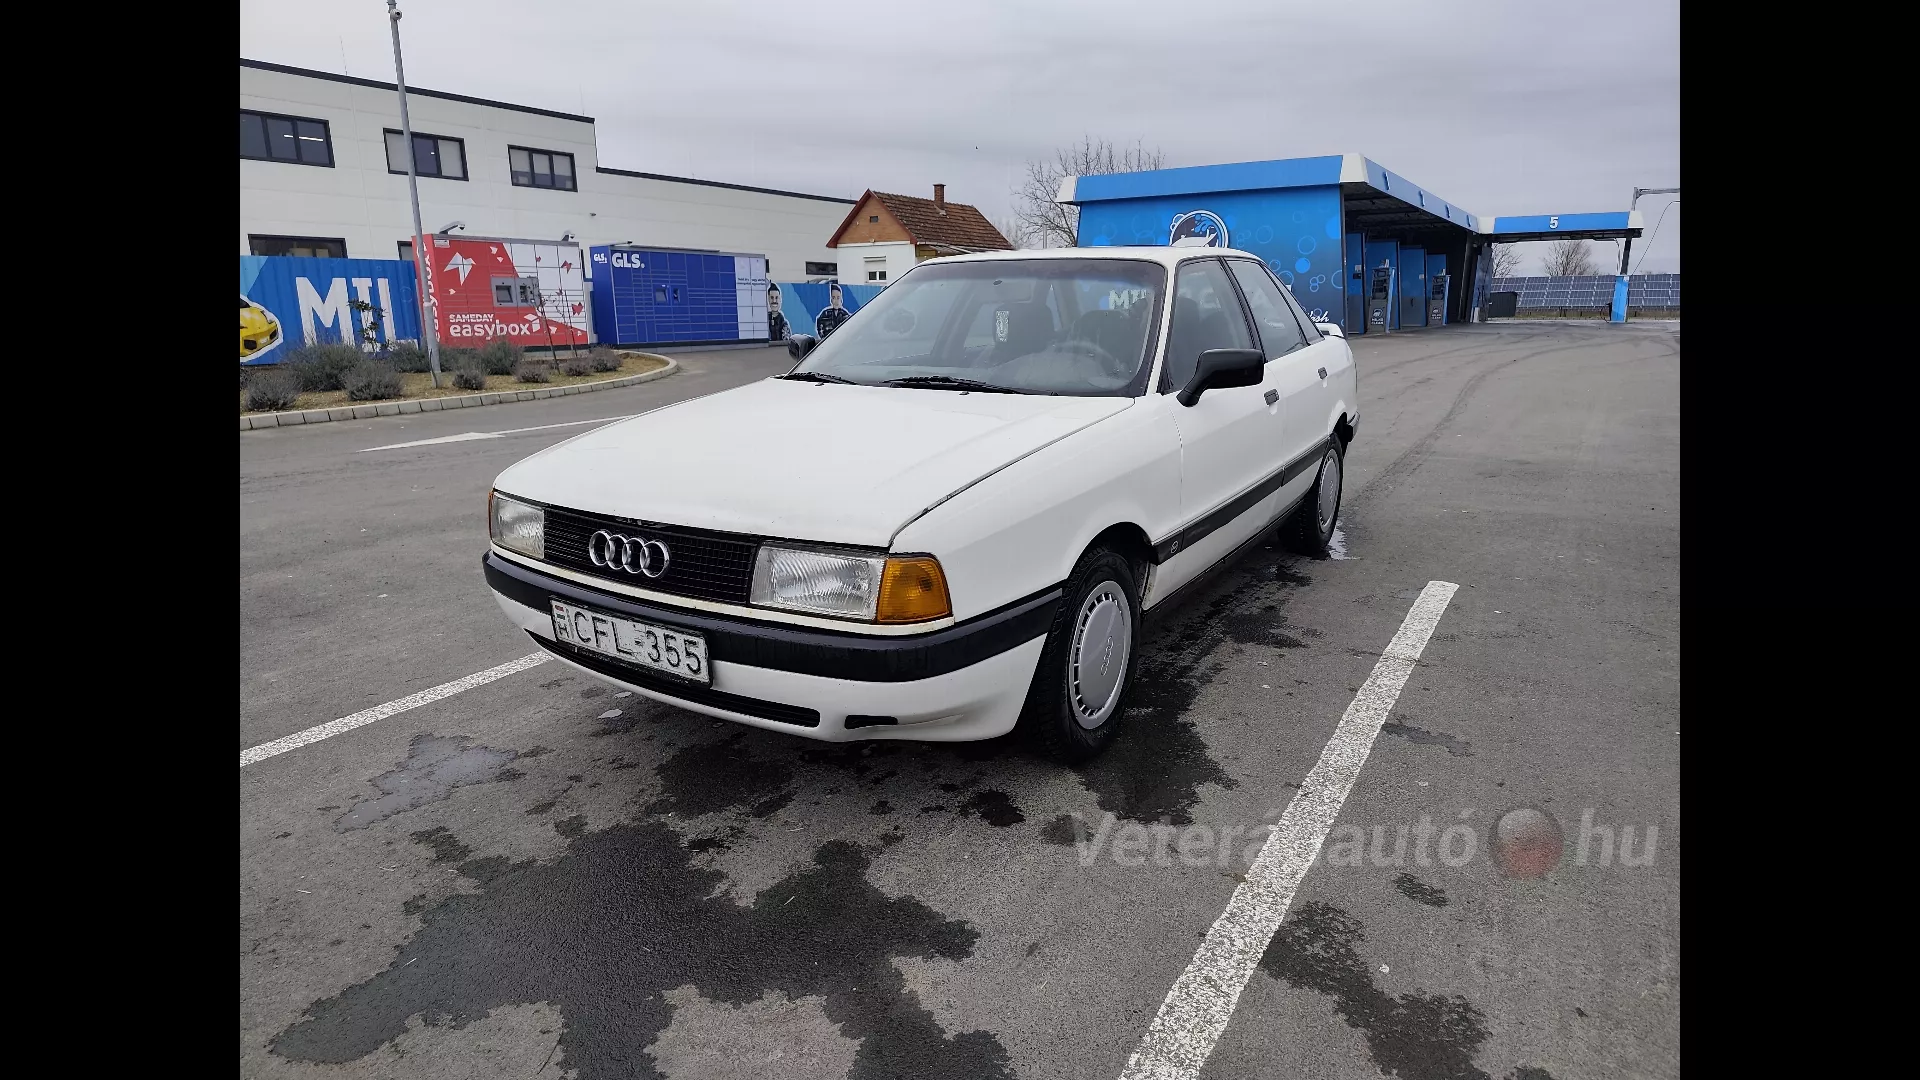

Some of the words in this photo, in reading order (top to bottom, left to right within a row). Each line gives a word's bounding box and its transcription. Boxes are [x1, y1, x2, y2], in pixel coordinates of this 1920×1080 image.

[1549, 216, 1559, 229] 5
[449, 314, 494, 323] SAMEDAY
[449, 319, 531, 341] easybox
[573, 611, 701, 675] CFL-355
